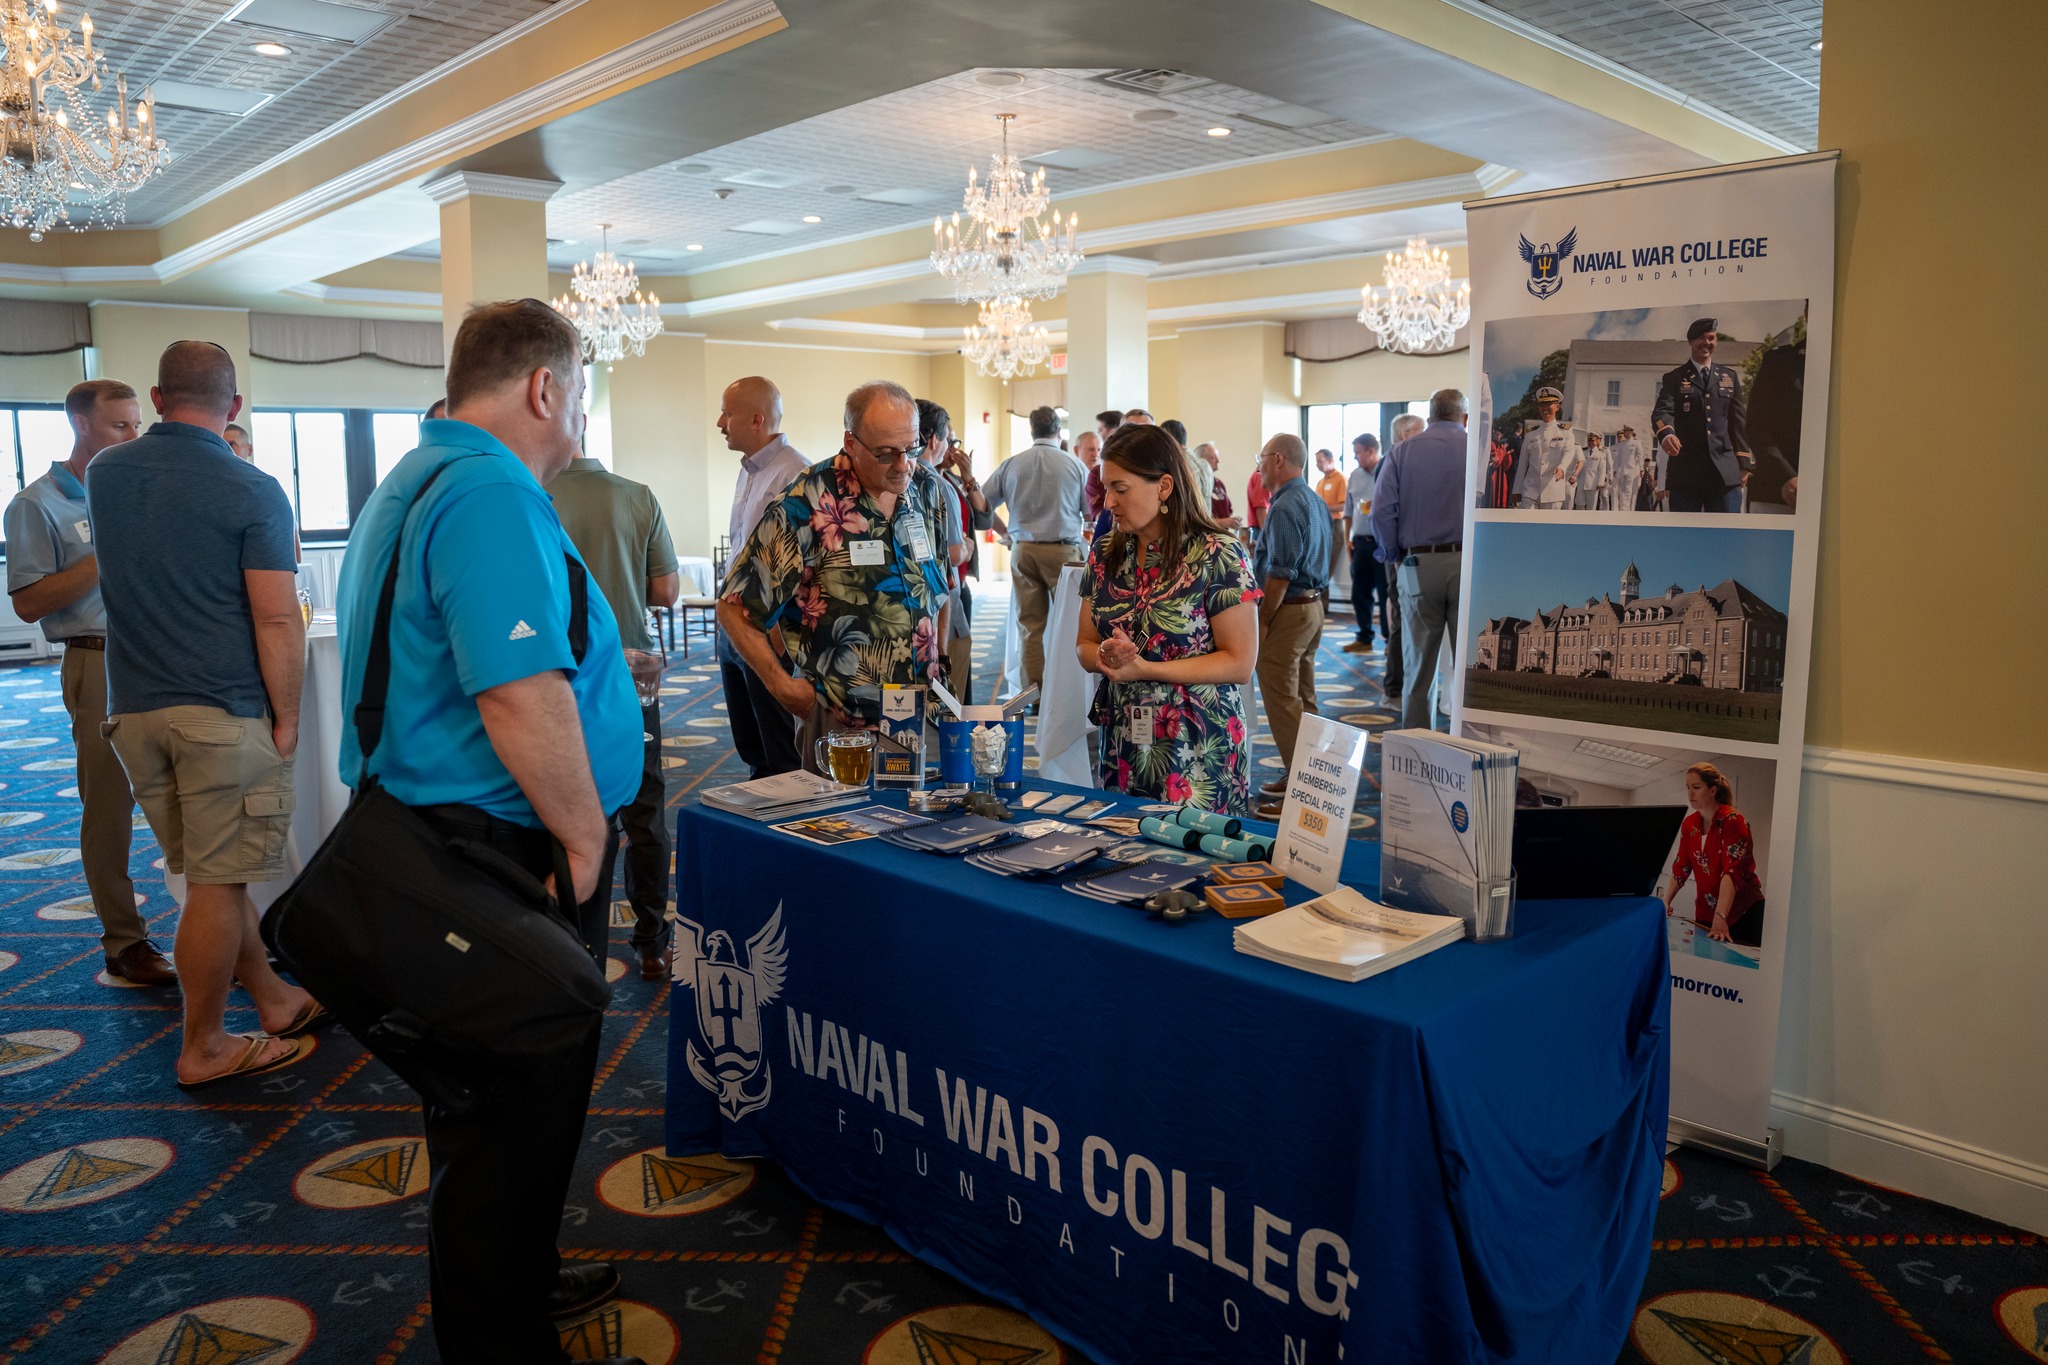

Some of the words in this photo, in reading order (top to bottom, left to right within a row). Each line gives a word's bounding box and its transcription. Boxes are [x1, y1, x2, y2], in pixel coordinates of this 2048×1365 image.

[1573, 250, 1627, 274] NAVAL
[1632, 246, 1675, 267] WAR
[1680, 237, 1768, 263] COLLEGE
[1590, 264, 1744, 286] FOUNDATION
[509, 629, 537, 641] adidas
[885, 763, 911, 773] AWAITS
[1308, 756, 1342, 778] LIFETIME
[1389, 754, 1418, 777] THE
[1420, 761, 1466, 793] BRIDGE
[1296, 771, 1347, 798] MEMBERSHIP
[1290, 788, 1320, 810] SPECIAL
[1322, 800, 1345, 819] PRICE
[1303, 811, 1323, 832] $350
[787, 1005, 924, 1127] NAVAL
[935, 1067, 1062, 1193] WAR
[838, 1107, 1308, 1365] FOUNDATION
